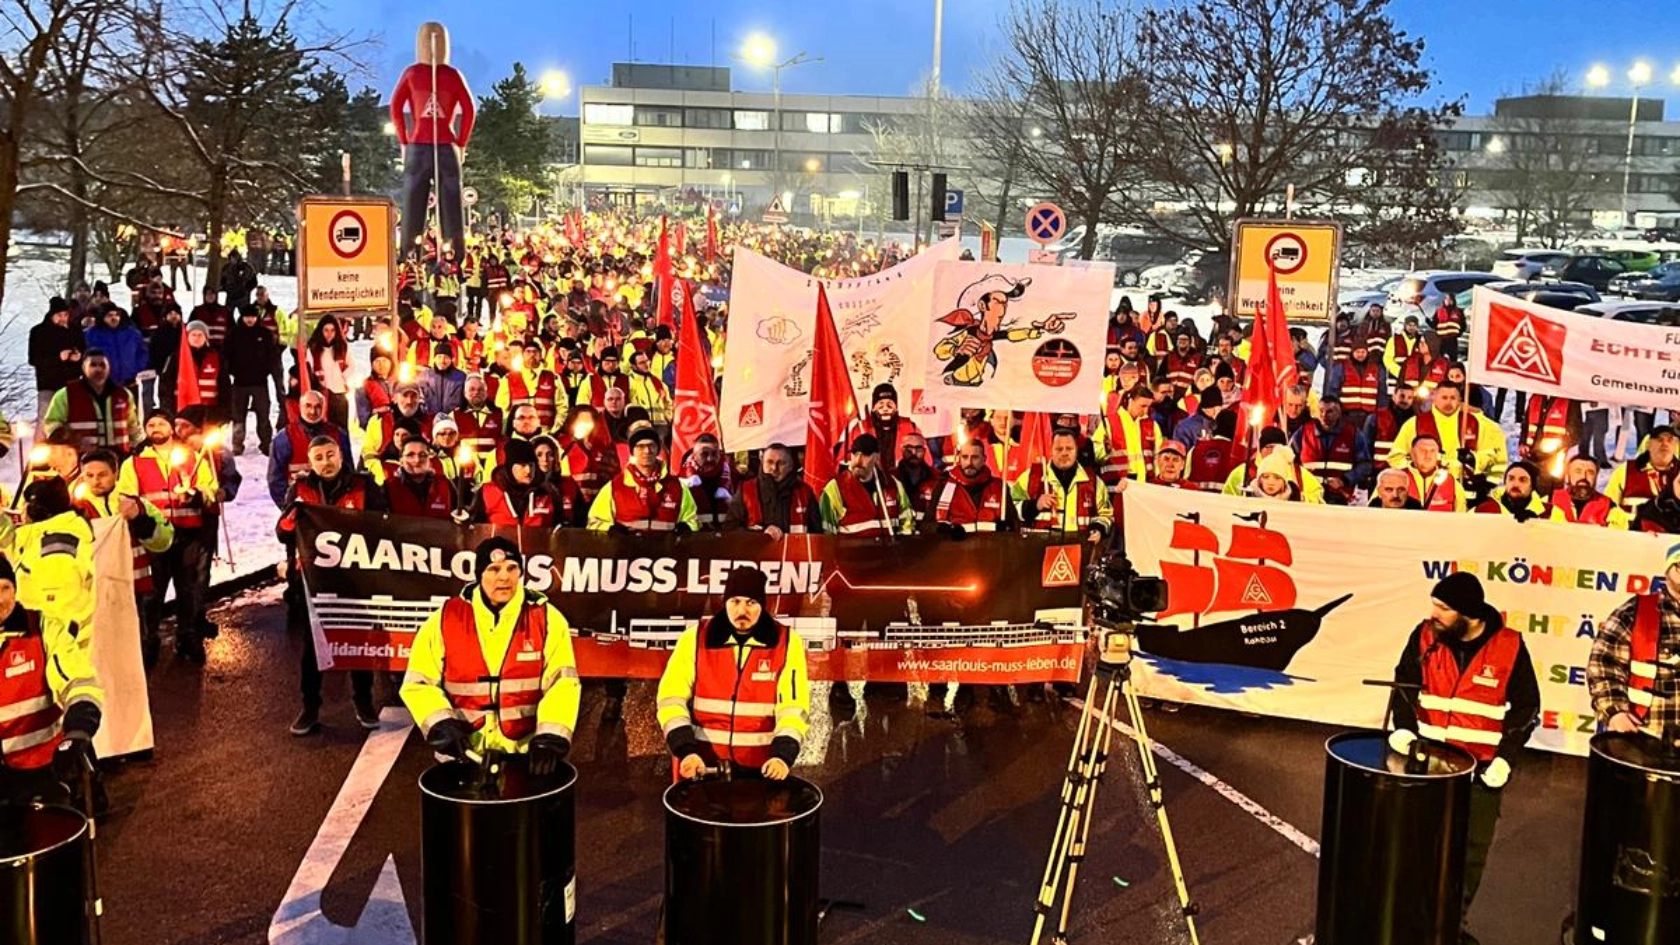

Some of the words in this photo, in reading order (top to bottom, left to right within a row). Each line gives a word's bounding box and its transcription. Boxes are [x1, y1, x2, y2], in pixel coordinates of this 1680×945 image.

[945, 192, 958, 211] P
[337, 271, 359, 282] keine
[311, 287, 385, 301] Wendemöglichkeit
[1278, 286, 1296, 295] eine
[1665, 332, 1680, 345] Fü
[1590, 338, 1672, 361] ECHTE
[1661, 368, 1680, 380] fü
[561, 556, 677, 593] MUSS
[686, 557, 823, 594] LEEN!
[1487, 557, 1619, 592] KÖNNEN
[1240, 621, 1278, 634] Bereich
[1279, 619, 1287, 630] 2
[397, 643, 411, 658] is
[897, 656, 1077, 673] www.saarlouis-muss-leben.de
